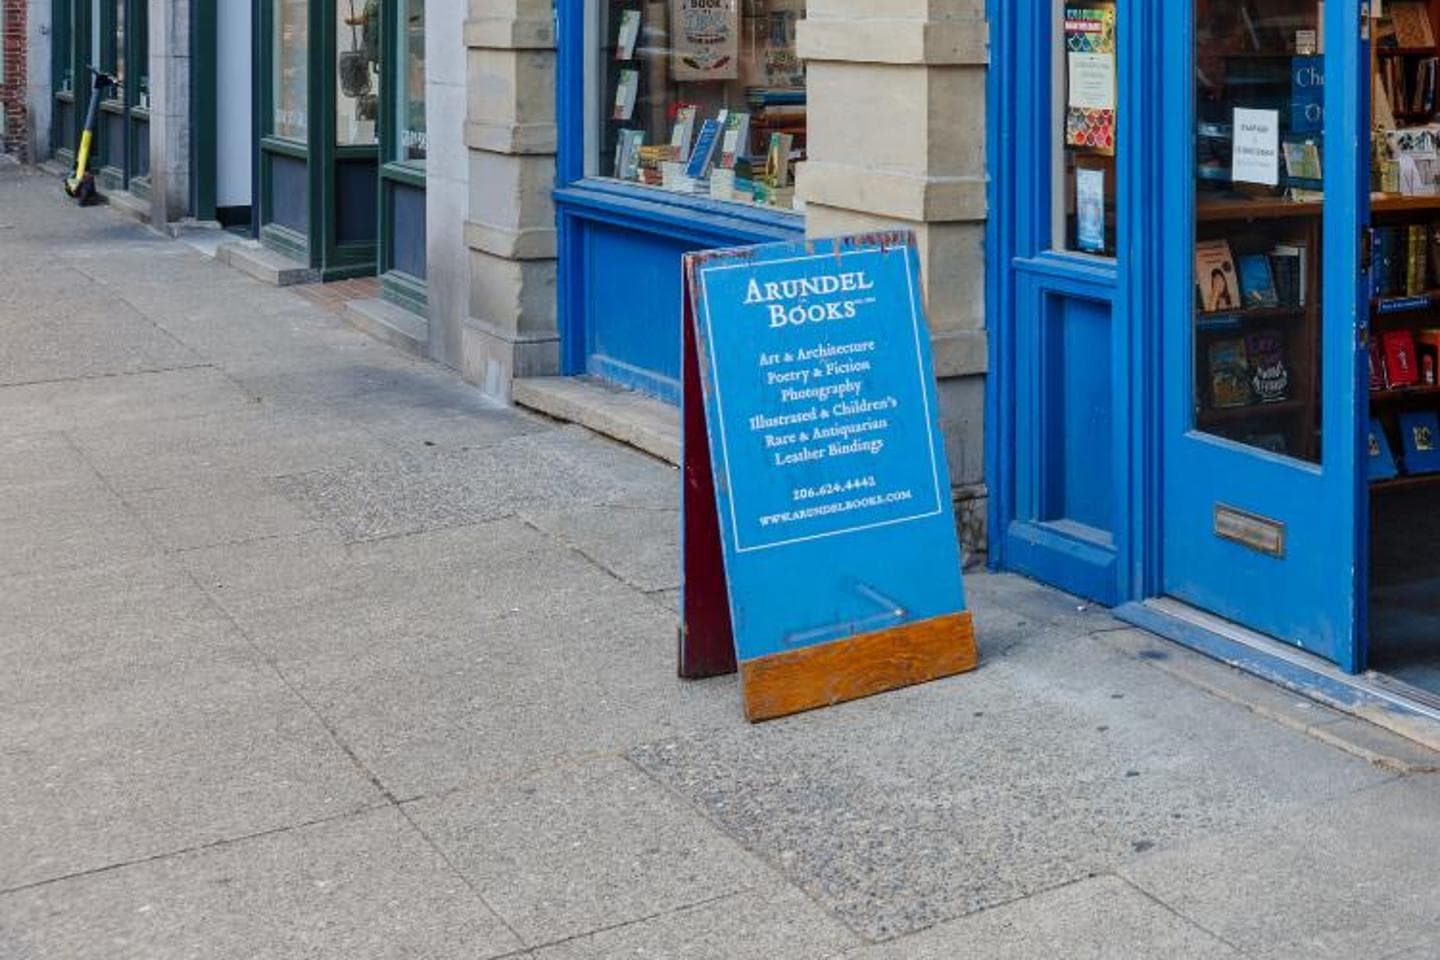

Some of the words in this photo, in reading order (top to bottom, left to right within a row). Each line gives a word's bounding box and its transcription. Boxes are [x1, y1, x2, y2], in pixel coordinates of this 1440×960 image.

[743, 271, 875, 304] ARUNDEL
[767, 300, 856, 328] BOOKS
[759, 353, 780, 366] Art
[783, 352, 794, 363] &
[797, 340, 875, 361] Architecture
[767, 369, 810, 385] Poetry
[813, 367, 823, 378] &
[826, 358, 871, 376] Fiction
[780, 378, 862, 402] Photography
[750, 407, 818, 430] Illustrated
[820, 409, 830, 420] &
[765, 434, 796, 448] Rare
[799, 431, 809, 442] &
[812, 418, 888, 440] Antiquarian
[775, 447, 826, 466] Leather
[828, 438, 884, 456] Bindings
